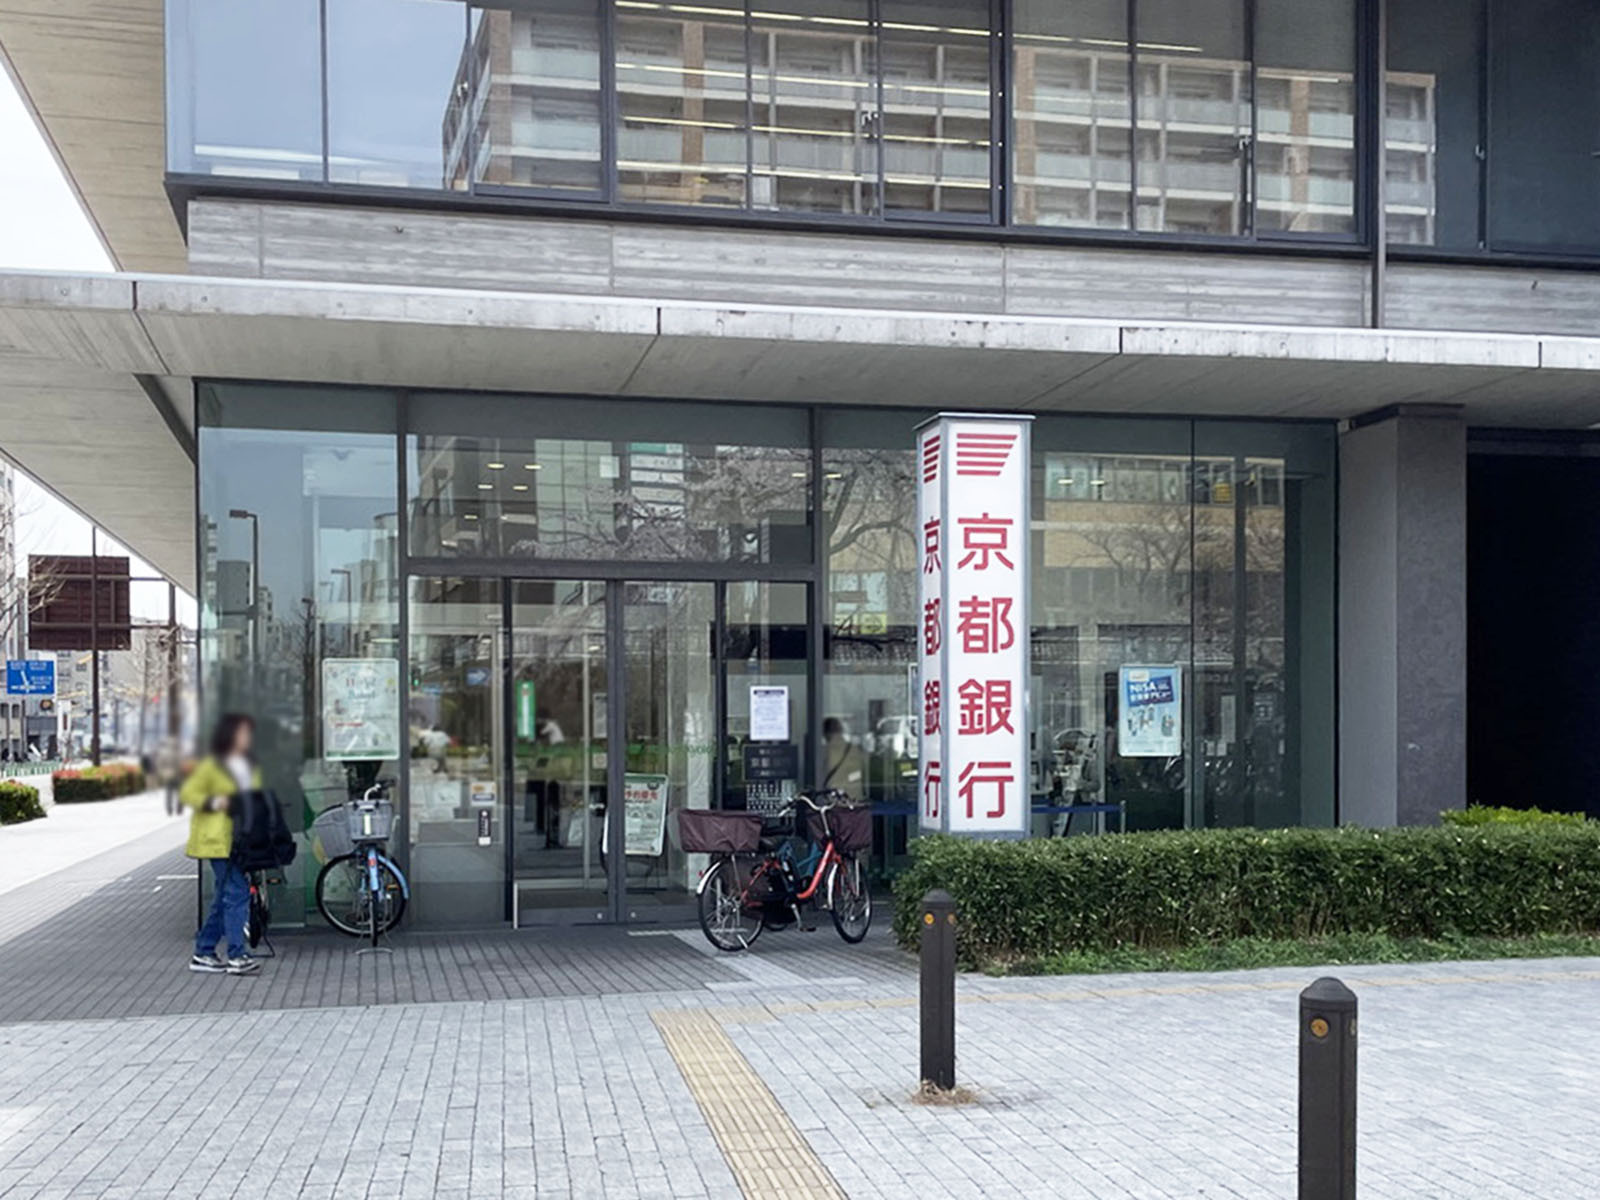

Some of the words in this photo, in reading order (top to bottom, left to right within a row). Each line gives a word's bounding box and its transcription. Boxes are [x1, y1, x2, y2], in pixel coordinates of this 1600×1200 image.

[923, 516, 941, 818] 京都銀行
[957, 512, 1015, 819] 京都銀行
[1129, 681, 1158, 694] NISA
